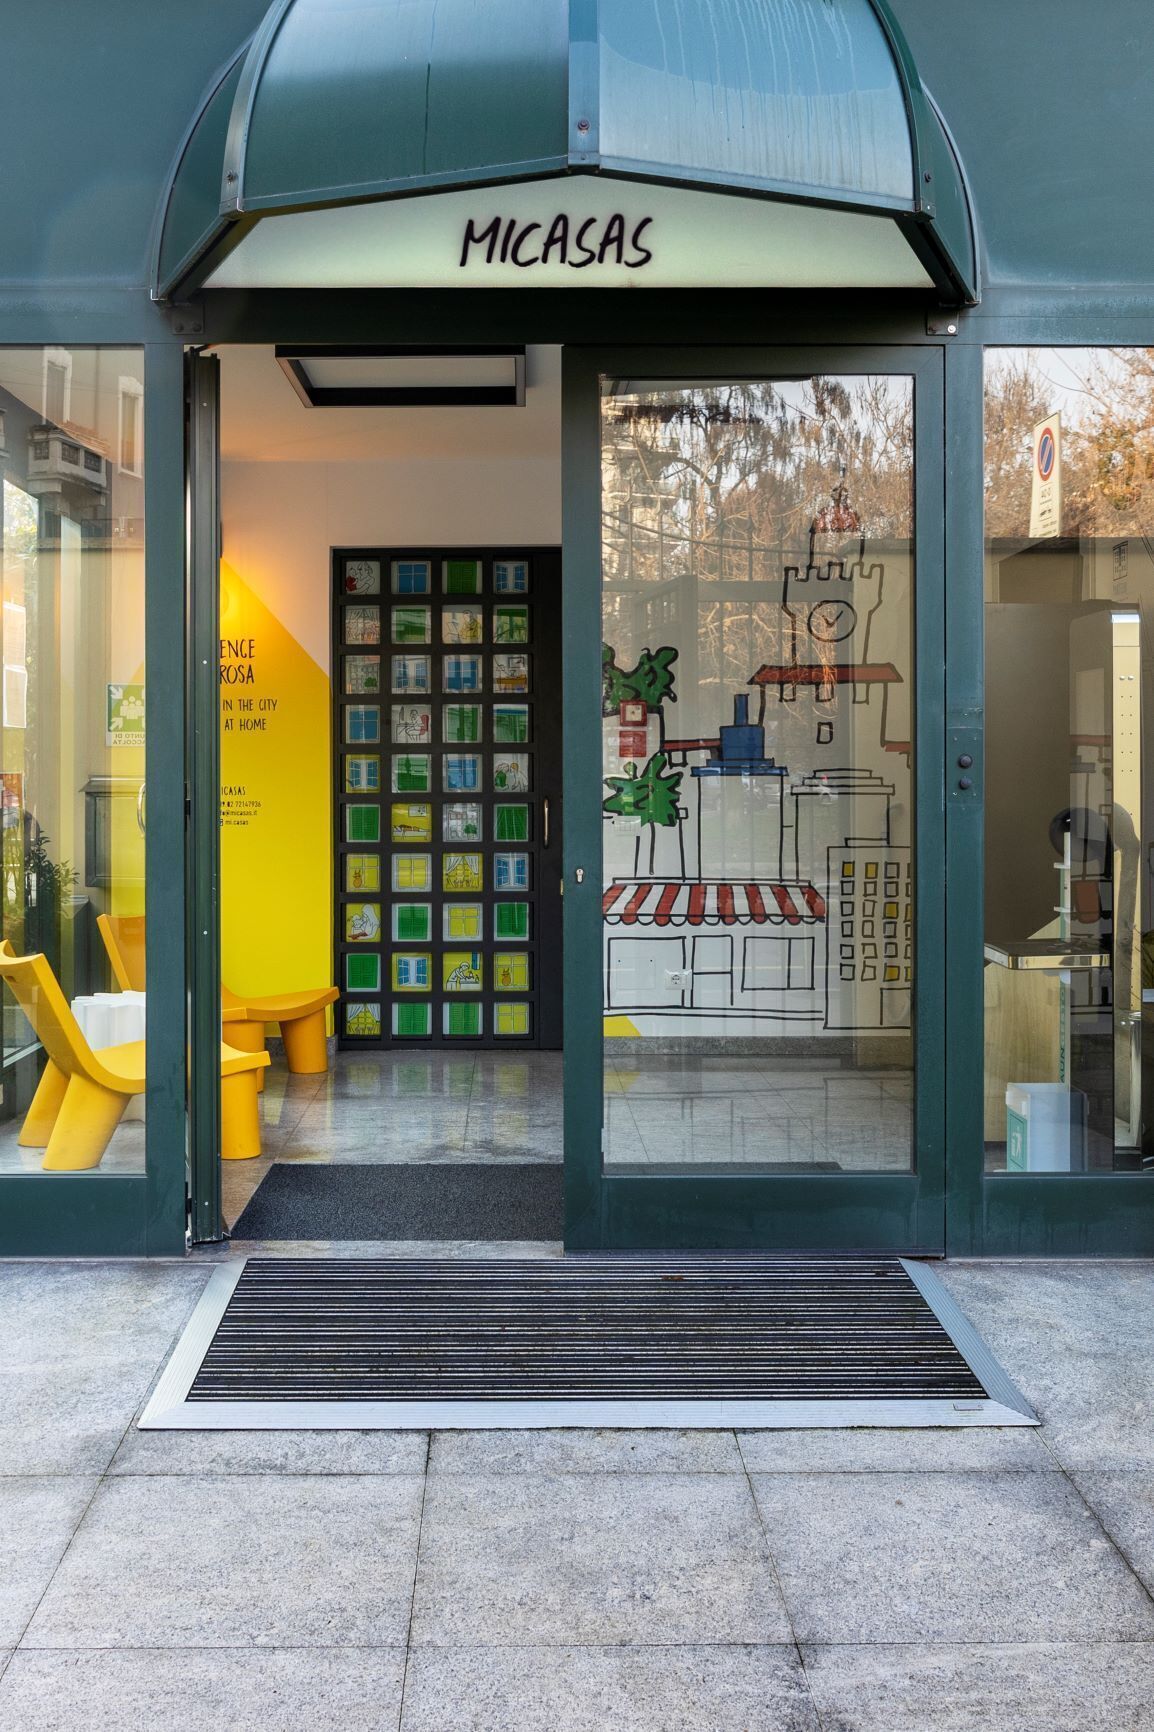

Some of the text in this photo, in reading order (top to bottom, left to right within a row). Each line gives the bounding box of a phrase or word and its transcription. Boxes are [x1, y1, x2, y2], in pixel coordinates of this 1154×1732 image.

[459, 213, 653, 268] MICASAS
[219, 639, 255, 659] ENCE
[219, 664, 254, 685] ROSA
[222, 698, 277, 712] IN THE CITY
[224, 718, 266, 731] AT HOME
